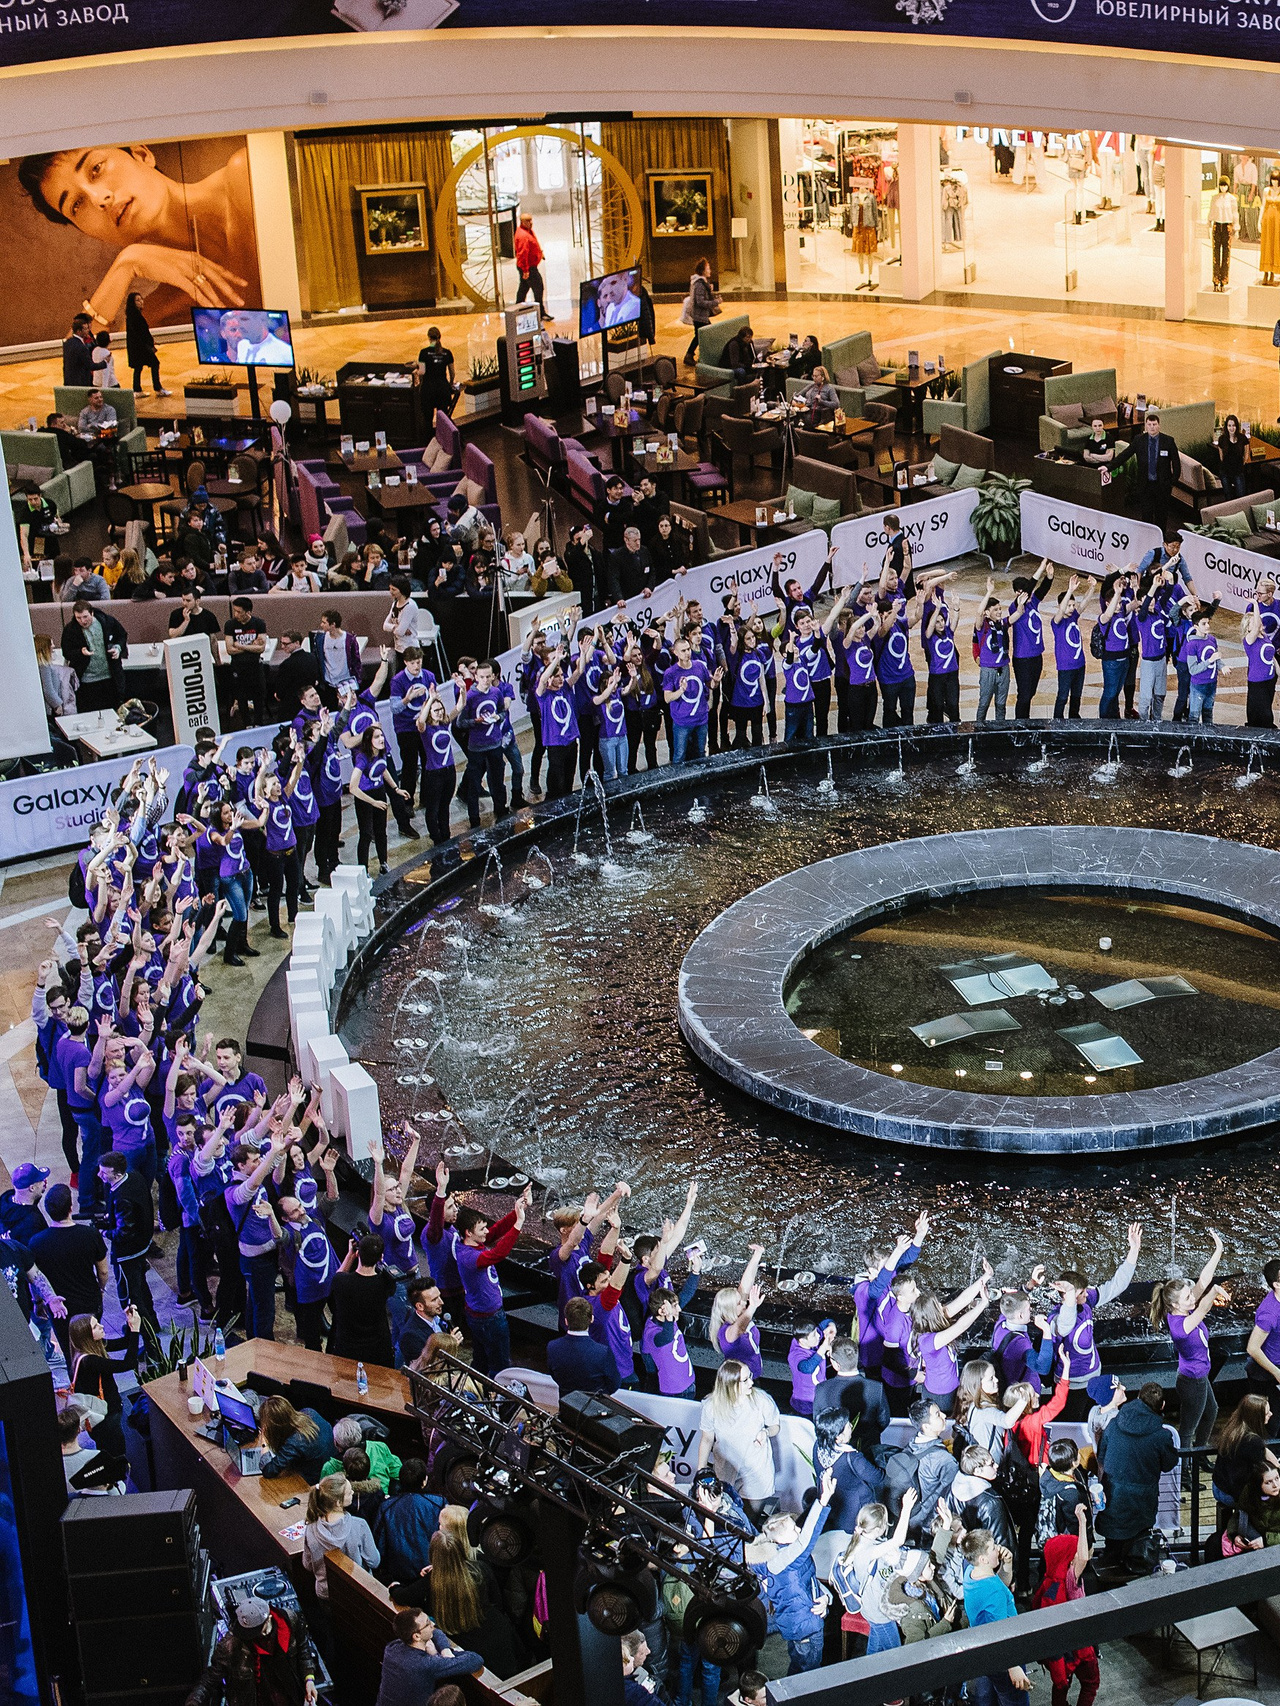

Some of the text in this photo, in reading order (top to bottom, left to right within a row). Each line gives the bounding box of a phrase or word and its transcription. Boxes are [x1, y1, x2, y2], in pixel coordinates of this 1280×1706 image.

[56, 3, 129, 26] ЗАВОД
[1096, 0, 1229, 26] ЮВЕЛИРНЫЙ
[955, 125, 1084, 151] FOREVER
[931, 511, 949, 532] S9
[1047, 515, 1130, 550] Galaxy S9
[1070, 543, 1105, 563] Studio
[1204, 552, 1262, 587] Galaxy
[1028, 608, 1043, 645] 9
[1065, 621, 1082, 660] 9
[1112, 617, 1130, 650] 9
[1151, 619, 1166, 649] 9
[855, 646, 874, 680] 9
[888, 631, 908, 670] 9
[935, 638, 955, 669] 9
[1260, 643, 1276, 676] 9
[181, 650, 207, 716] aroma
[740, 659, 762, 697] 9
[793, 667, 811, 701] 9
[188, 712, 209, 728] café
[551, 696, 572, 736] 9
[605, 699, 625, 735] 9
[431, 730, 452, 766] 9
[13, 782, 112, 816] Galaxy
[293, 771, 313, 814] 9
[272, 804, 292, 841] 9
[124, 1098, 151, 1141] 9
[393, 1214, 417, 1258] 9
[299, 1231, 331, 1285] 9
[672, 1328, 694, 1378] 9
